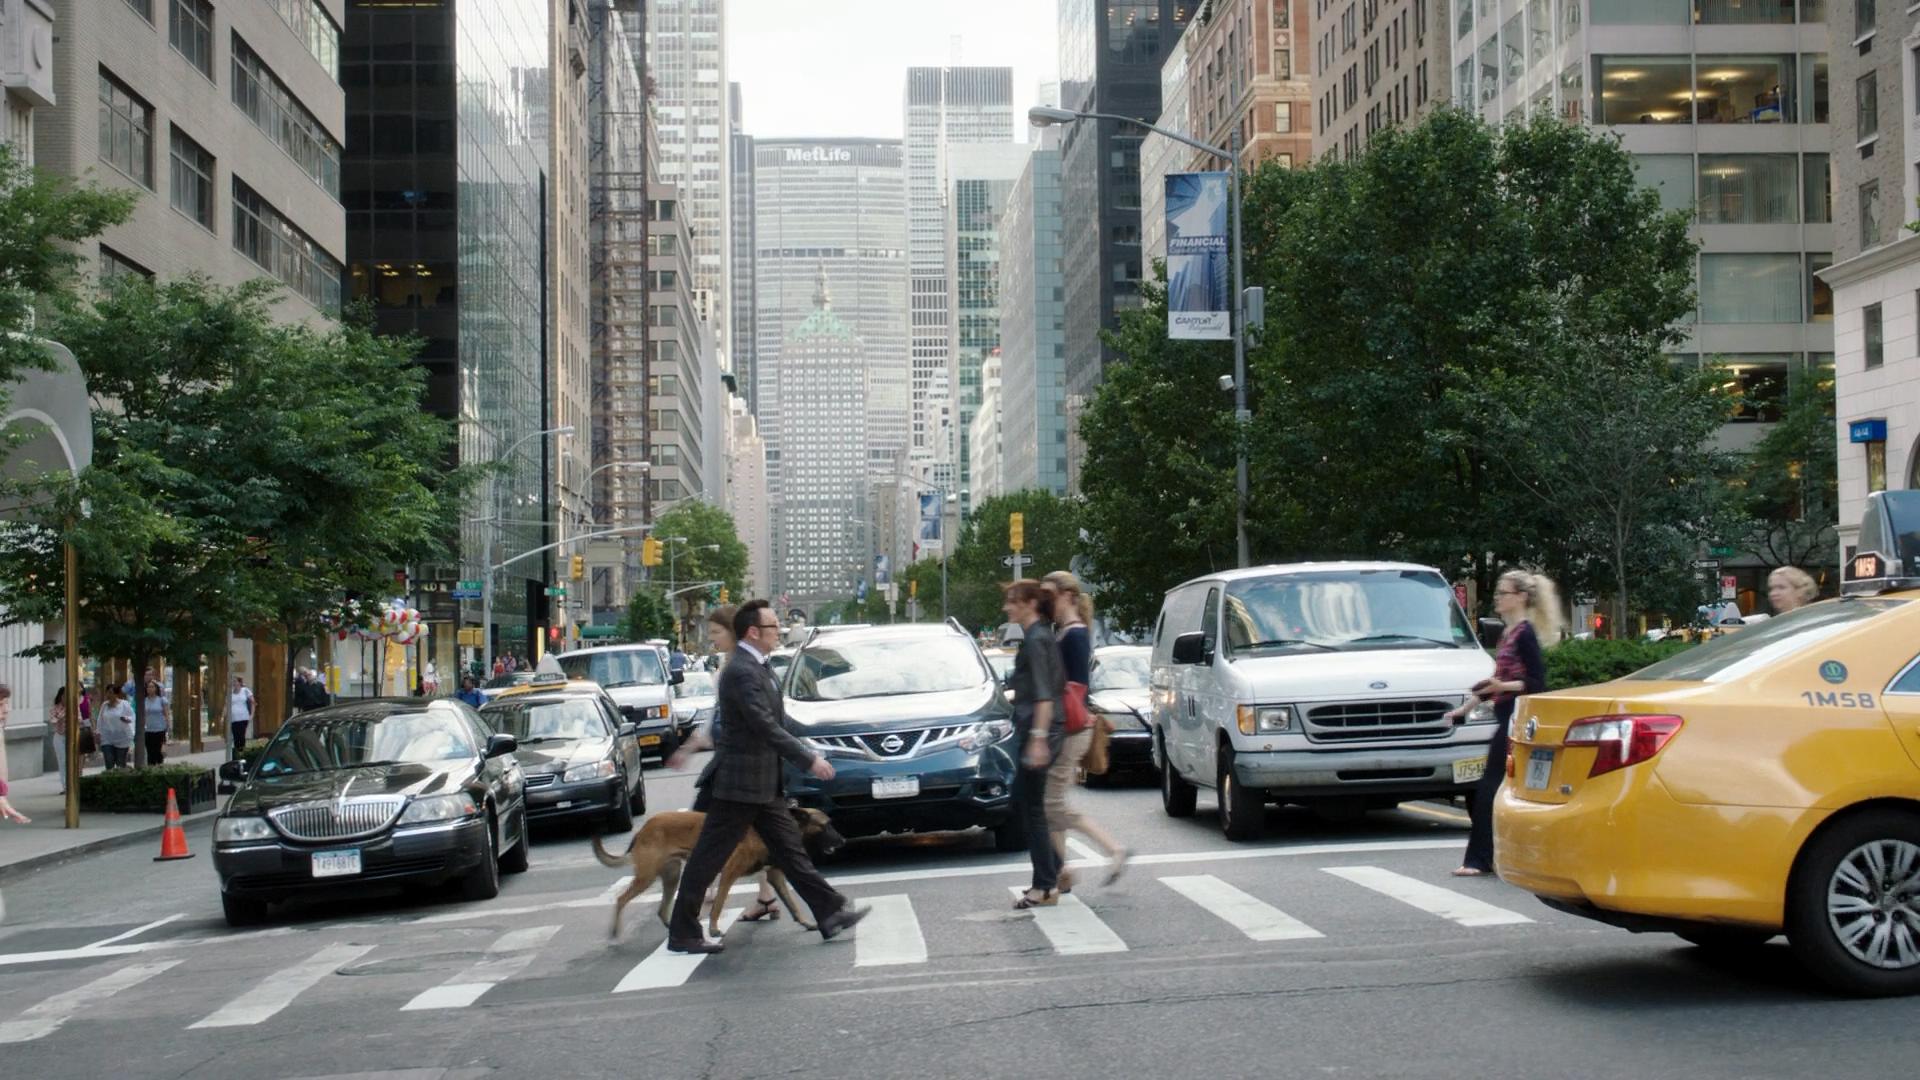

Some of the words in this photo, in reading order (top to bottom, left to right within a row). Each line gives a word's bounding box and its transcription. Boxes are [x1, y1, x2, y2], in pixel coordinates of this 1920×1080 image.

[786, 146, 851, 161] MetLife
[1169, 237, 1226, 248] FINANCIAL
[1801, 691, 1875, 708] 1M58
